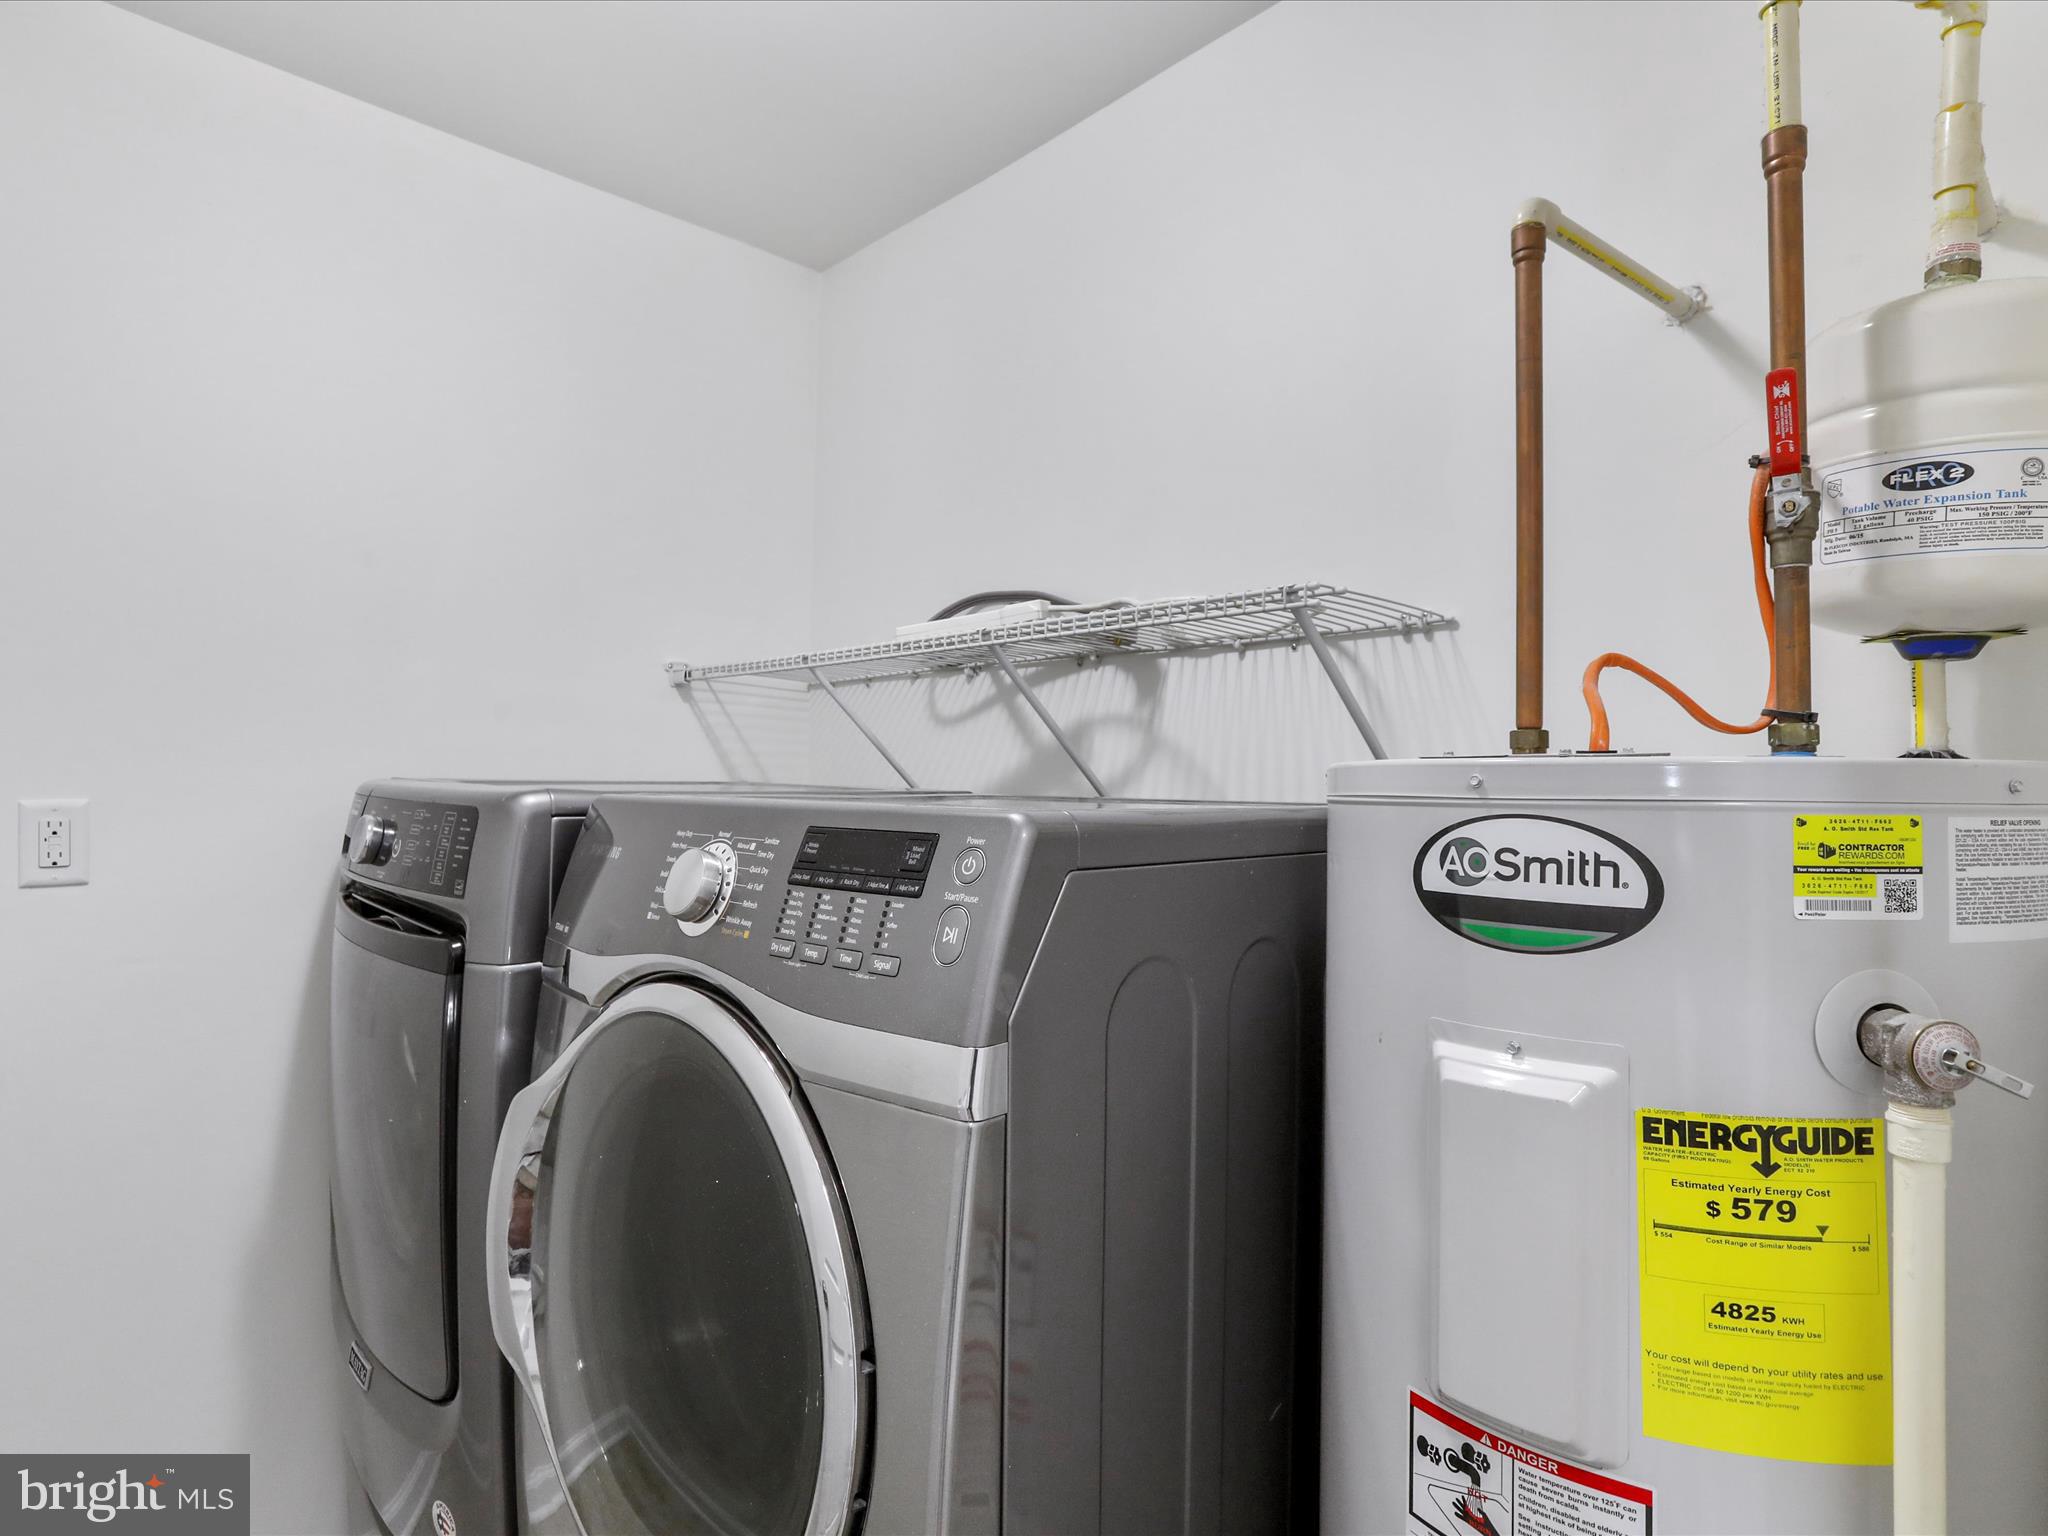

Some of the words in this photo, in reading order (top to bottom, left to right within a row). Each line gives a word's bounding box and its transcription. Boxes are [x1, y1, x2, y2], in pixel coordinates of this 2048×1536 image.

[1890, 469, 1944, 485] FLEX
[1949, 468, 1965, 478] 2
[1842, 503, 1880, 516] Potable
[1883, 498, 1920, 508] Water
[1924, 491, 1991, 504] Expansion
[1996, 489, 2028, 498] Tank
[966, 835, 986, 846] Power
[1493, 847, 1620, 889] Smith
[743, 900, 757, 908] Refresh
[944, 890, 979, 904] Start/Pause
[771, 942, 779, 951] Dry
[779, 943, 791, 953] Level
[804, 948, 818, 959] Temp.
[839, 954, 852, 963] Time
[873, 960, 891, 971] Signal
[1642, 1116, 1874, 1160] ENERGYGUIDE
[1671, 1178, 1725, 1192] Estimated
[1728, 1184, 1761, 1196] Yearly
[1765, 1187, 1802, 1198] Energy
[1806, 1189, 1831, 1198] Cost
[1705, 1200, 1721, 1219] $
[1730, 1197, 1797, 1223] 579
[1705, 1237, 1722, 1245] Cost
[1725, 1239, 1748, 1248] Range
[1759, 1242, 1785, 1250] Similar
[1711, 1301, 1776, 1323] 4825
[1782, 1317, 1805, 1325] KWH
[1708, 1323, 1747, 1333] Estimated
[1750, 1328, 1774, 1336] Yearly
[1777, 1330, 1804, 1339] Energy
[1645, 1349, 1669, 1360] Your
[1670, 1354, 1691, 1365] cost
[1693, 1358, 1710, 1368] will
[1712, 1360, 1750, 1374] depend
[1752, 1365, 1764, 1375] on
[1767, 1368, 1789, 1378] your
[1792, 1368, 1817, 1380] utility
[1820, 1370, 1844, 1380] rates
[1846, 1372, 1865, 1381] and
[1657, 1379, 1691, 1389] ELECTRIC
[1497, 1441, 1558, 1474] DANGER
[1467, 1487, 1488, 1502] HOT
[1518, 1467, 1537, 1479] Water
[1539, 1475, 1581, 1495] temperature
[1583, 1493, 1599, 1501] over
[1601, 1498, 1620, 1508] 125°F
[1623, 1505, 1637, 1514] can
[1518, 1476, 1538, 1487] cause
[1541, 1485, 1564, 1498] severe
[1568, 1495, 1589, 1506] burns
[1592, 1503, 1625, 1520] instantly
[1518, 1484, 1537, 1495] death
[1538, 1492, 1555, 1503] from
[1555, 1499, 1581, 1512] scalds.
[1518, 1494, 1548, 1511] Children,
[1550, 1508, 1580, 1523] disabled
[1582, 1520, 1596, 1528] and
[1597, 1525, 1623, 1536] elderly
[1518, 1513, 1531, 1523] See
[1526, 1505, 1551, 1519] highest
[1552, 1516, 1566, 1526] risk
[1567, 1521, 1575, 1529] of
[1576, 1525, 1597, 1536] being
[1518, 1522, 1542, 1536] setting
